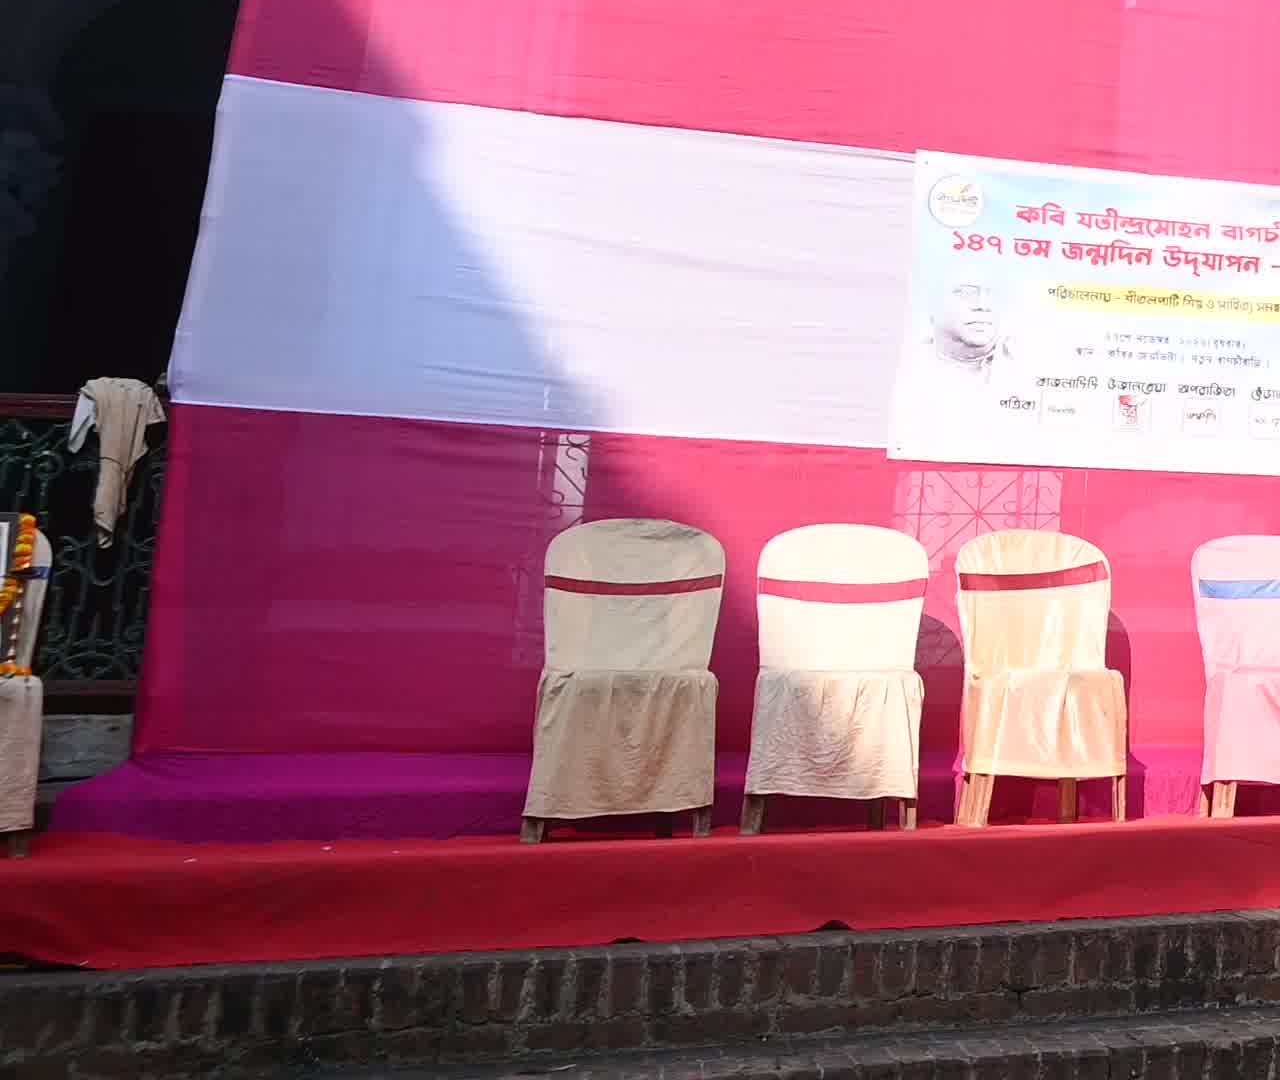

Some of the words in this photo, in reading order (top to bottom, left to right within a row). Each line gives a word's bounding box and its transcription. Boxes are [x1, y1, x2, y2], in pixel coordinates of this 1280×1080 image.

[1015, 202, 1065, 226] কবি
[1077, 207, 1211, 240] যতীন্দ্রমোহন
[952, 230, 1002, 255] ১৪৭
[1013, 236, 1051, 259] তম
[1062, 237, 1153, 266] জন্মদিন
